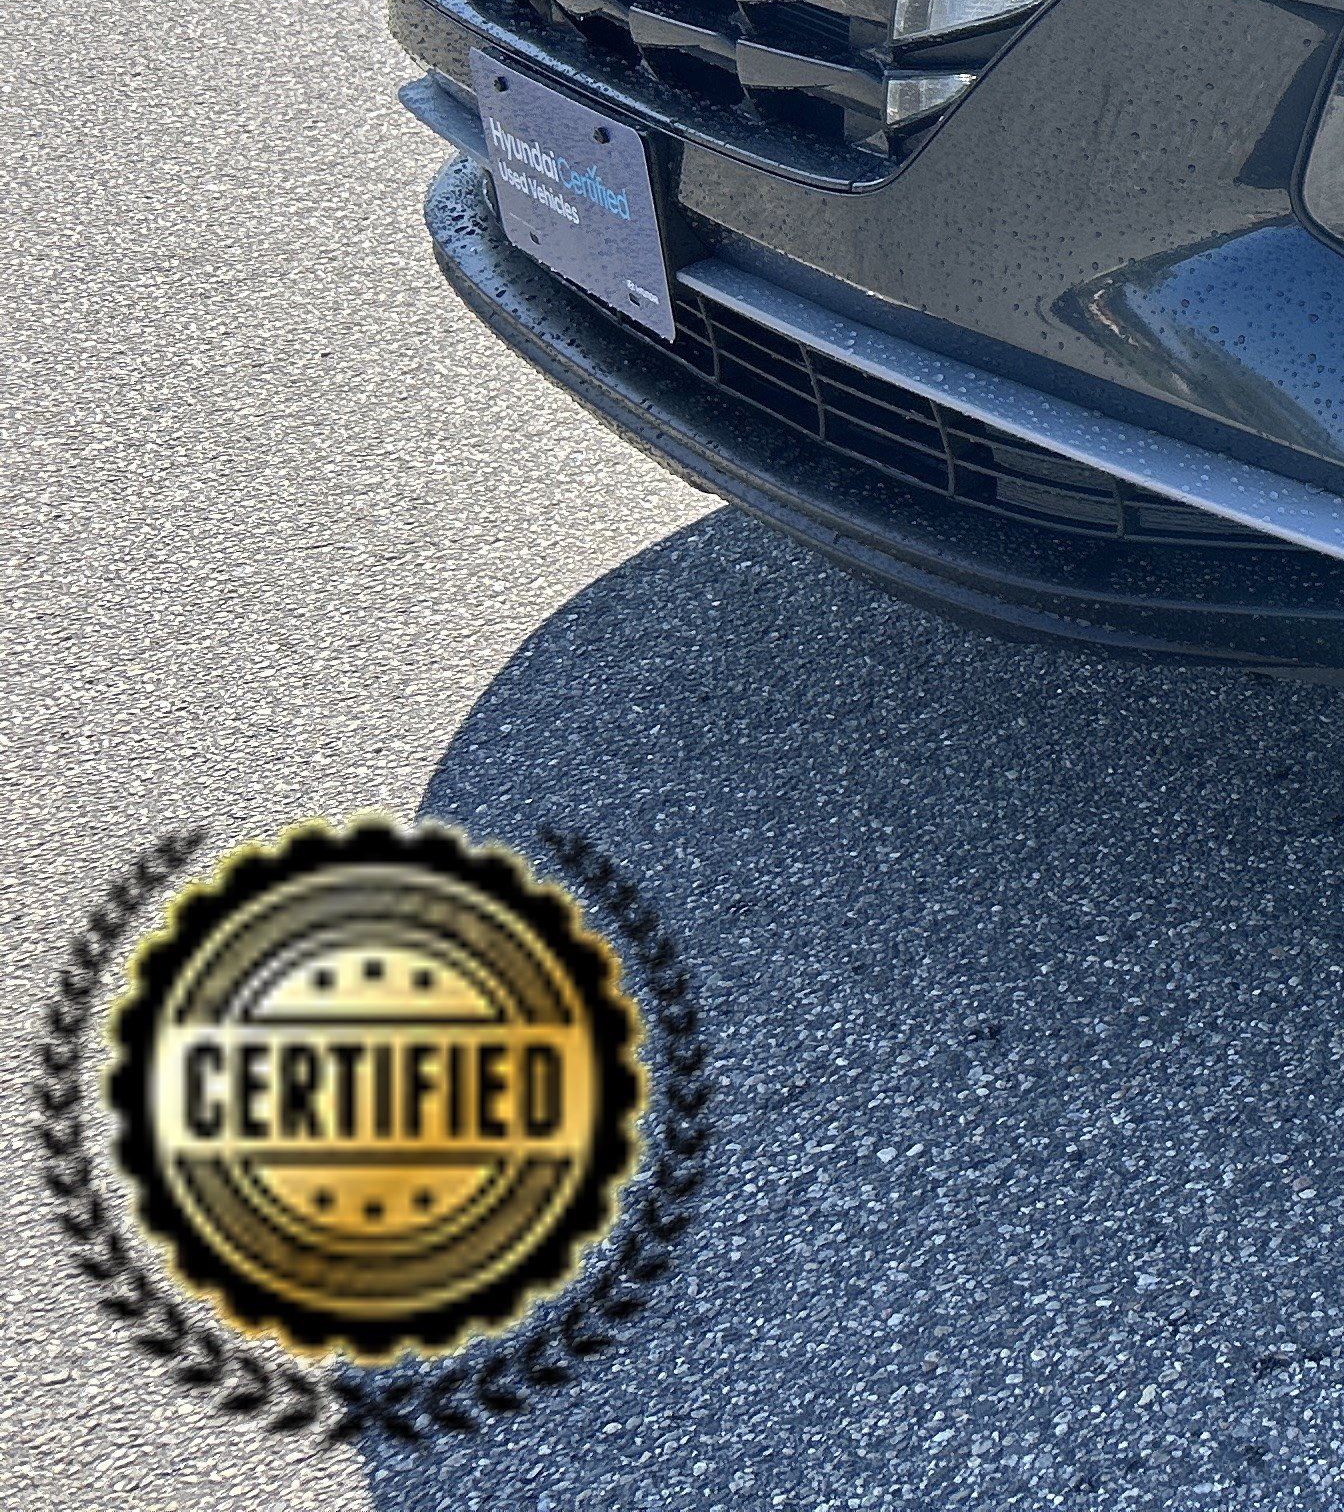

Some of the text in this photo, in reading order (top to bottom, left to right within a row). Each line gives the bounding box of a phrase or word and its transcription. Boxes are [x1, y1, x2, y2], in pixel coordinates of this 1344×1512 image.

[489, 116, 631, 221] Hyundai Certified
[497, 160, 530, 195] Used
[528, 177, 580, 225] Vehicles
